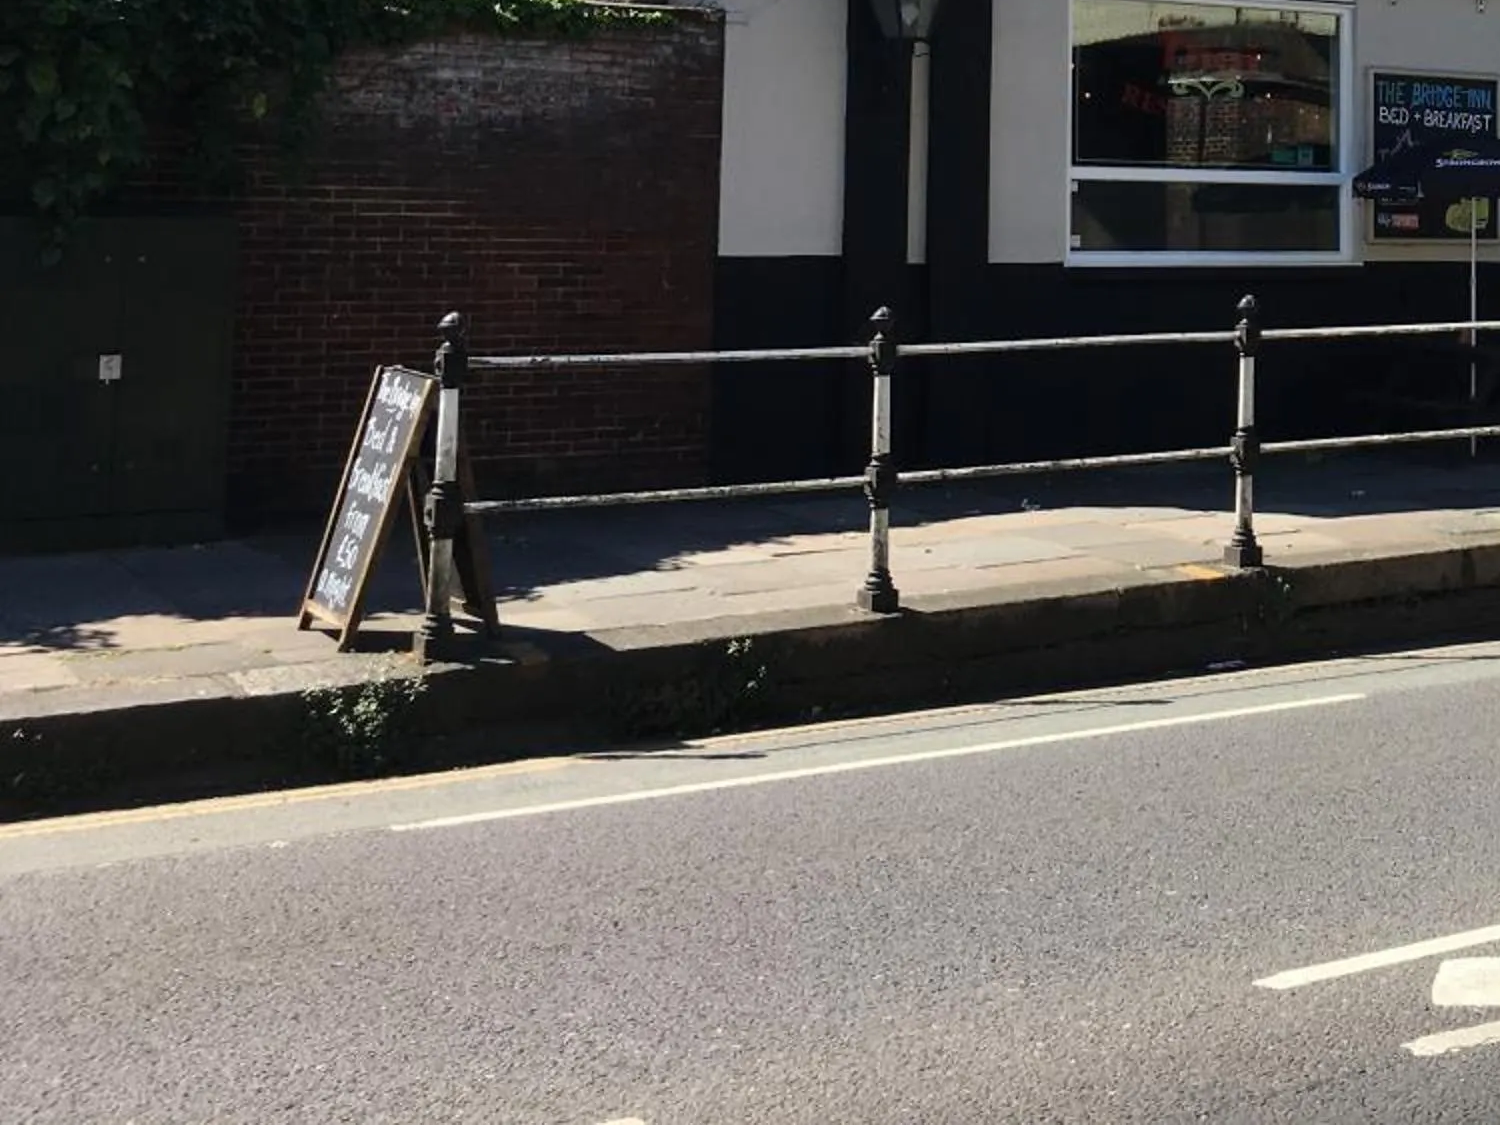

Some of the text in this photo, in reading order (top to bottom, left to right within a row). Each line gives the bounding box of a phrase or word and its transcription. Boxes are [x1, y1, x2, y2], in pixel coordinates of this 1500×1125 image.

[1377, 81, 1405, 105] THE
[1411, 82, 1463, 108] BRIDGE
[1379, 106, 1409, 125] BED
[1424, 109, 1493, 132] BREAKFAST
